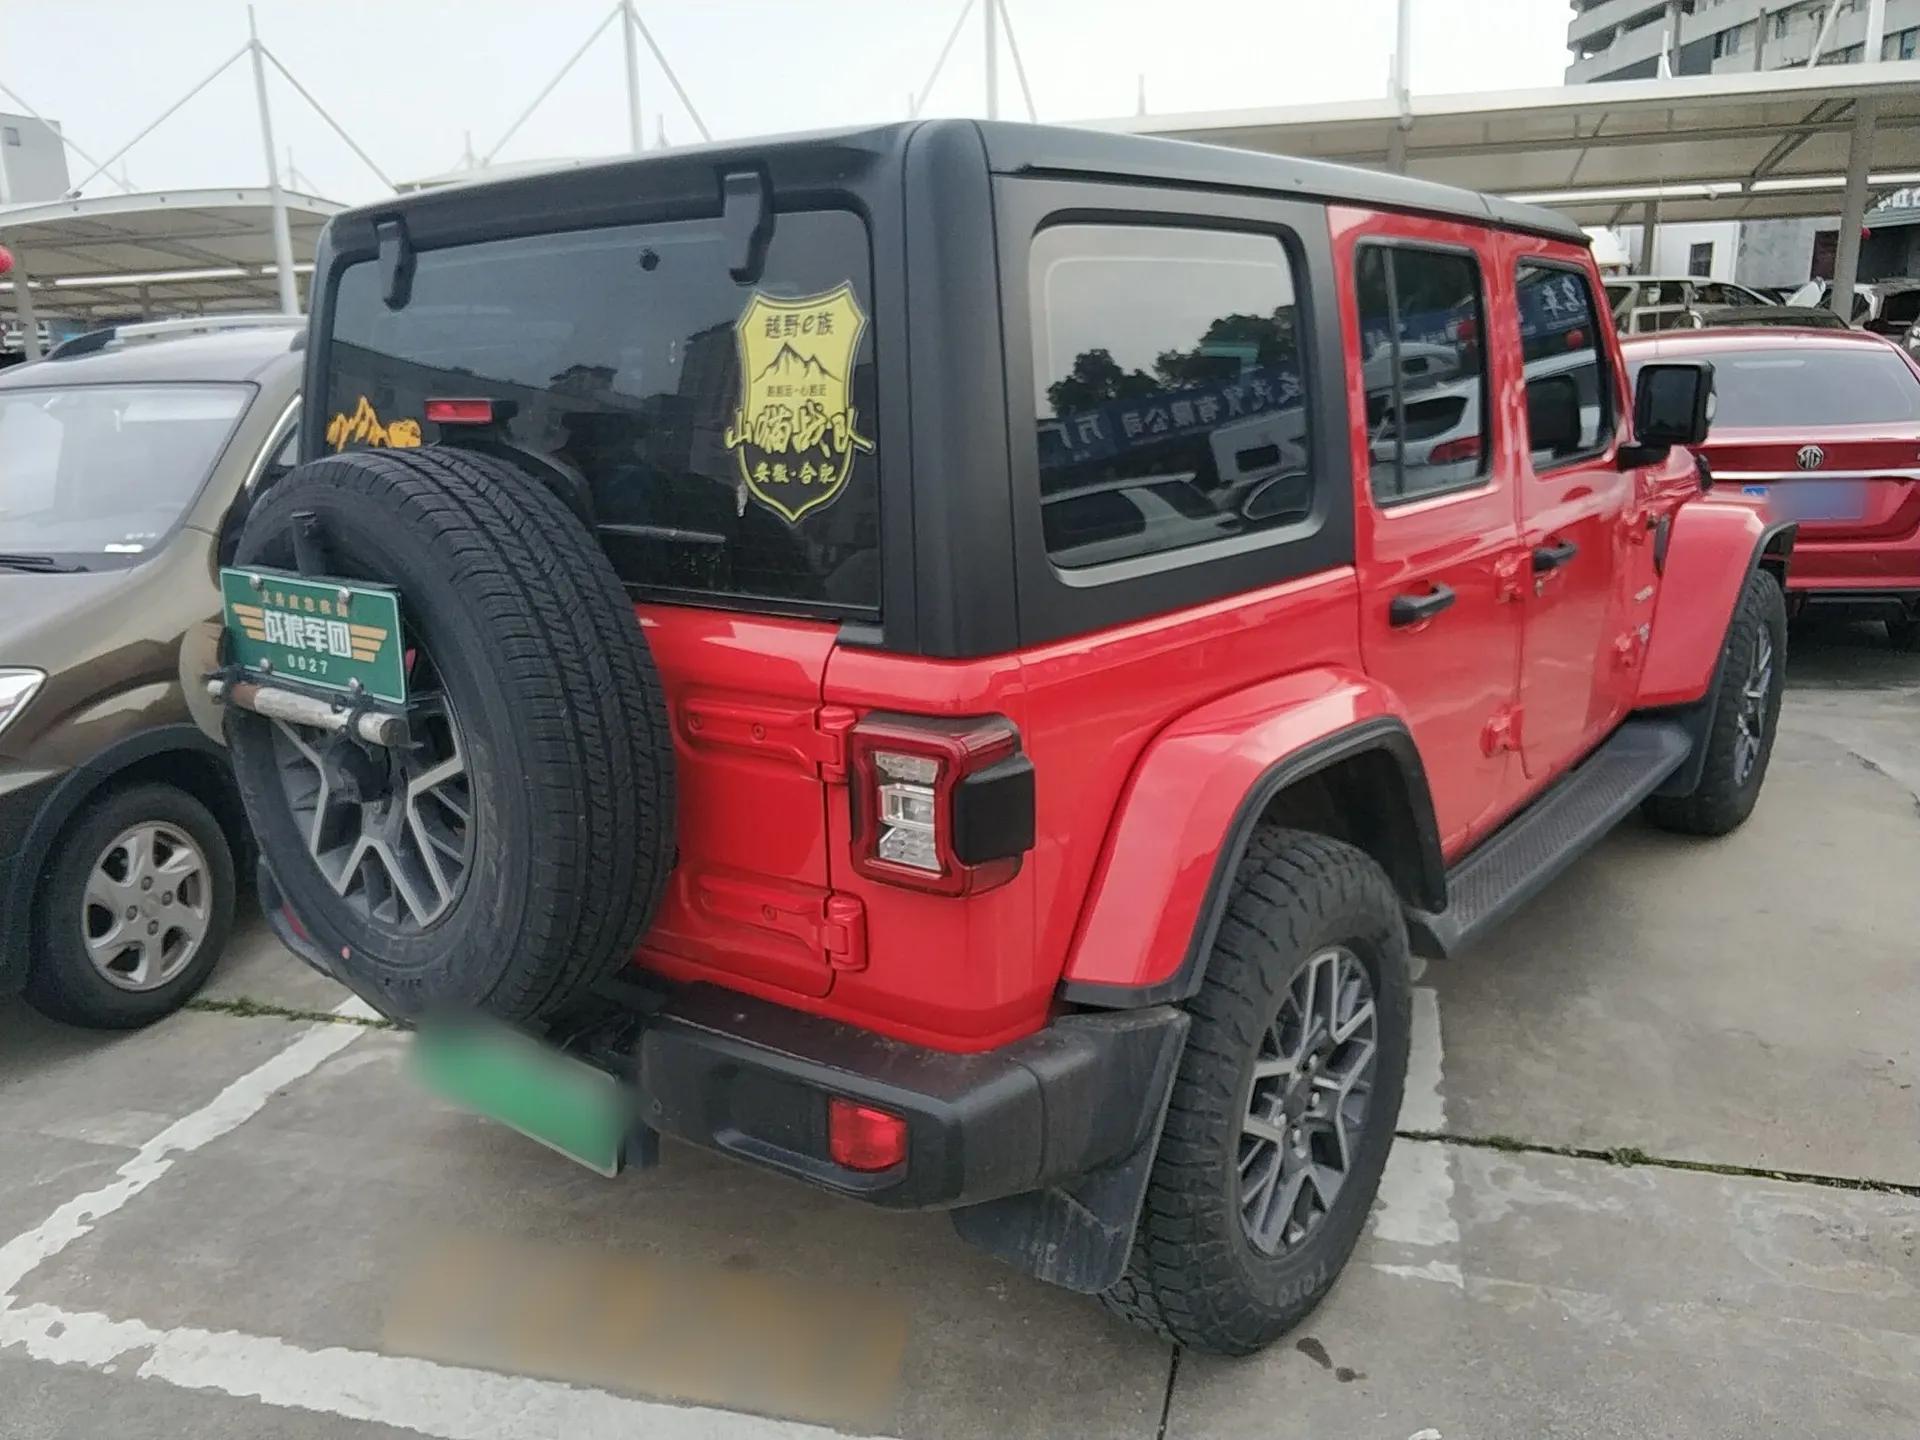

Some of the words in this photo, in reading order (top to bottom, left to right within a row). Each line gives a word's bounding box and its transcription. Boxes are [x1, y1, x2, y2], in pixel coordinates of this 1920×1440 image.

[764, 312, 834, 339] 越野e族
[287, 653, 329, 675] 0027
